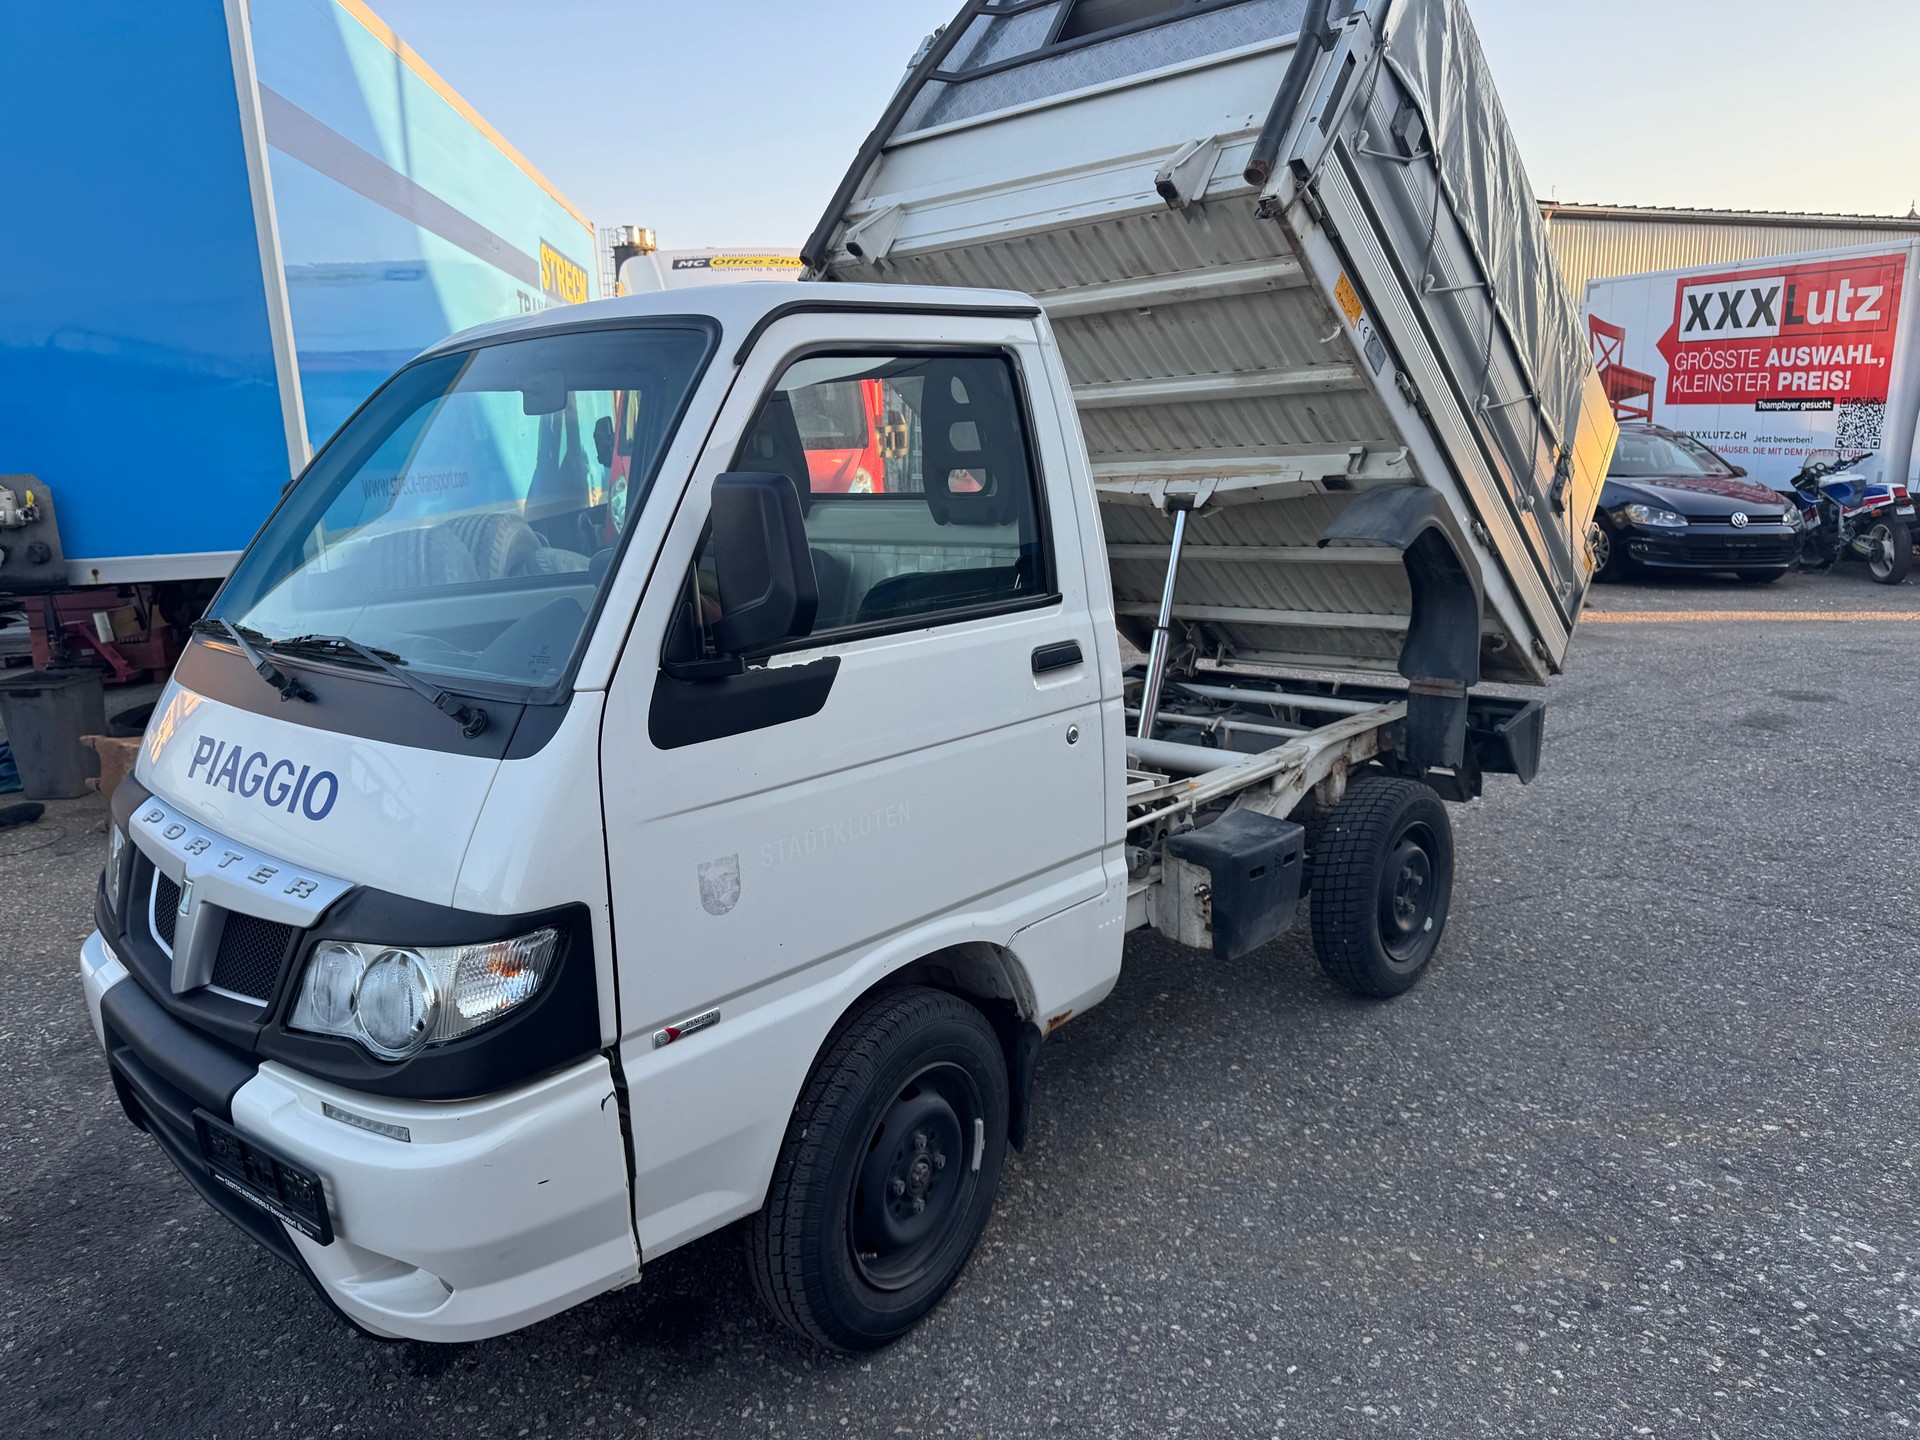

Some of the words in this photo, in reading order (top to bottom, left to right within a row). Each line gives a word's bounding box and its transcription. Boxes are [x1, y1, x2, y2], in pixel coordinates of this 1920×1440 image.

[541, 243, 587, 304] STRECK
[678, 259, 706, 267] MC
[713, 258, 763, 266] Office
[768, 258, 803, 267] Sho
[1683, 278, 1884, 333] XXXLutz
[1673, 347, 1760, 371] GRÖSSTE
[1764, 344, 1886, 369] AUSWAHL,
[1671, 372, 1770, 393] KLEINSTER
[1777, 370, 1851, 391] PREIS!
[1757, 400, 1799, 411] Teamplayer
[1800, 400, 1832, 410] gesucht
[1767, 447, 1782, 455] MIT
[1784, 448, 1803, 456] DEM
[1805, 449, 1834, 457] ROTEN
[1773, 436, 1813, 444] bewerben!
[361, 470, 470, 498] www.streck-transport.com
[187, 735, 339, 821] PIAGGIO
[142, 807, 319, 898] PORTER
[686, 1011, 714, 1028] PIAGGIO
